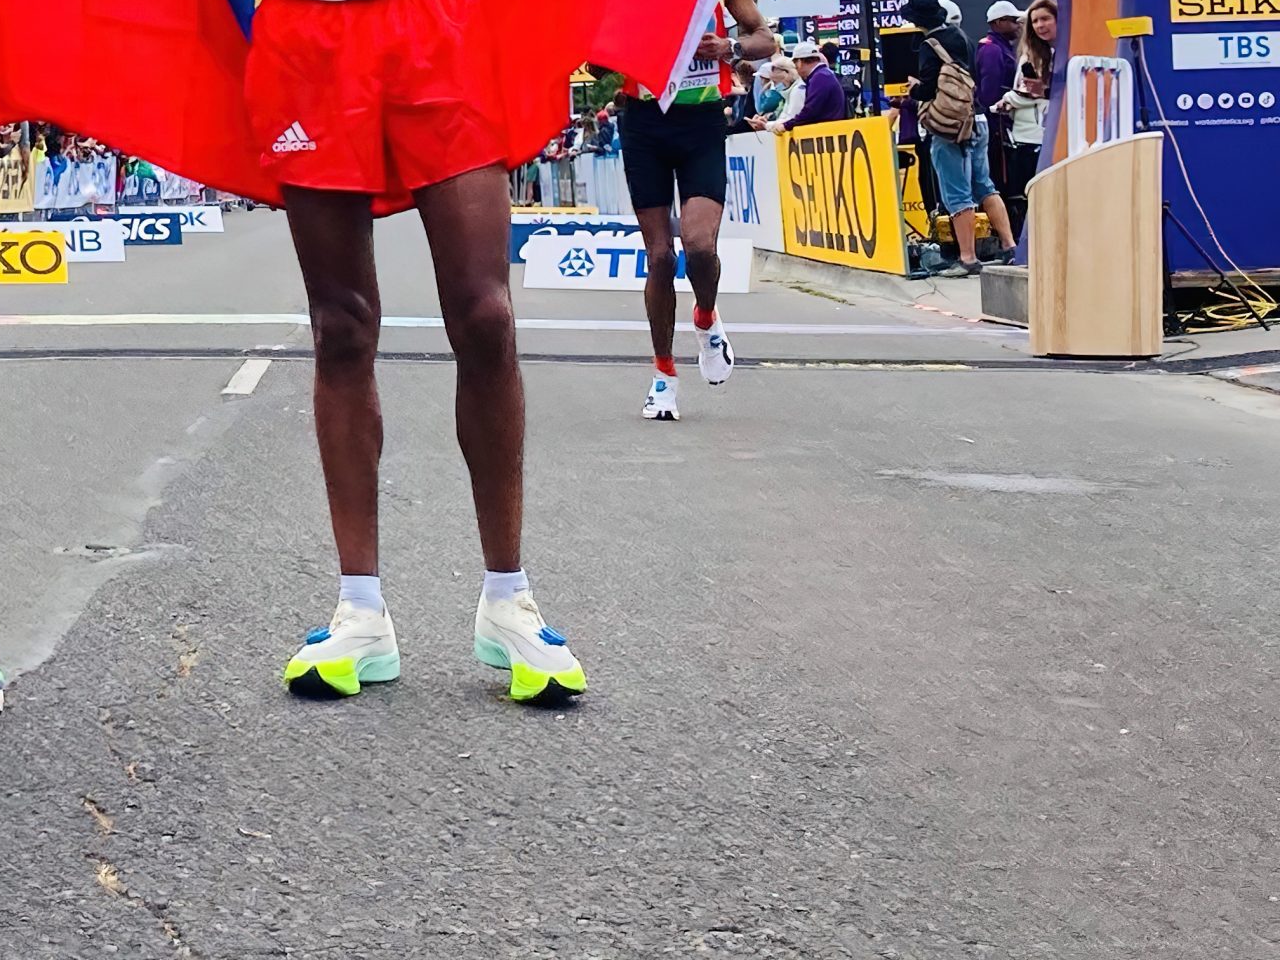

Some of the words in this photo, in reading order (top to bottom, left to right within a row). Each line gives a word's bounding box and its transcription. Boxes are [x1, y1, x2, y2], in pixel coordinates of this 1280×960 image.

[838, 19, 860, 31] KEN
[839, 34, 860, 46] ETH
[1218, 35, 1270, 58] TBS
[788, 129, 877, 259] SEIKO
